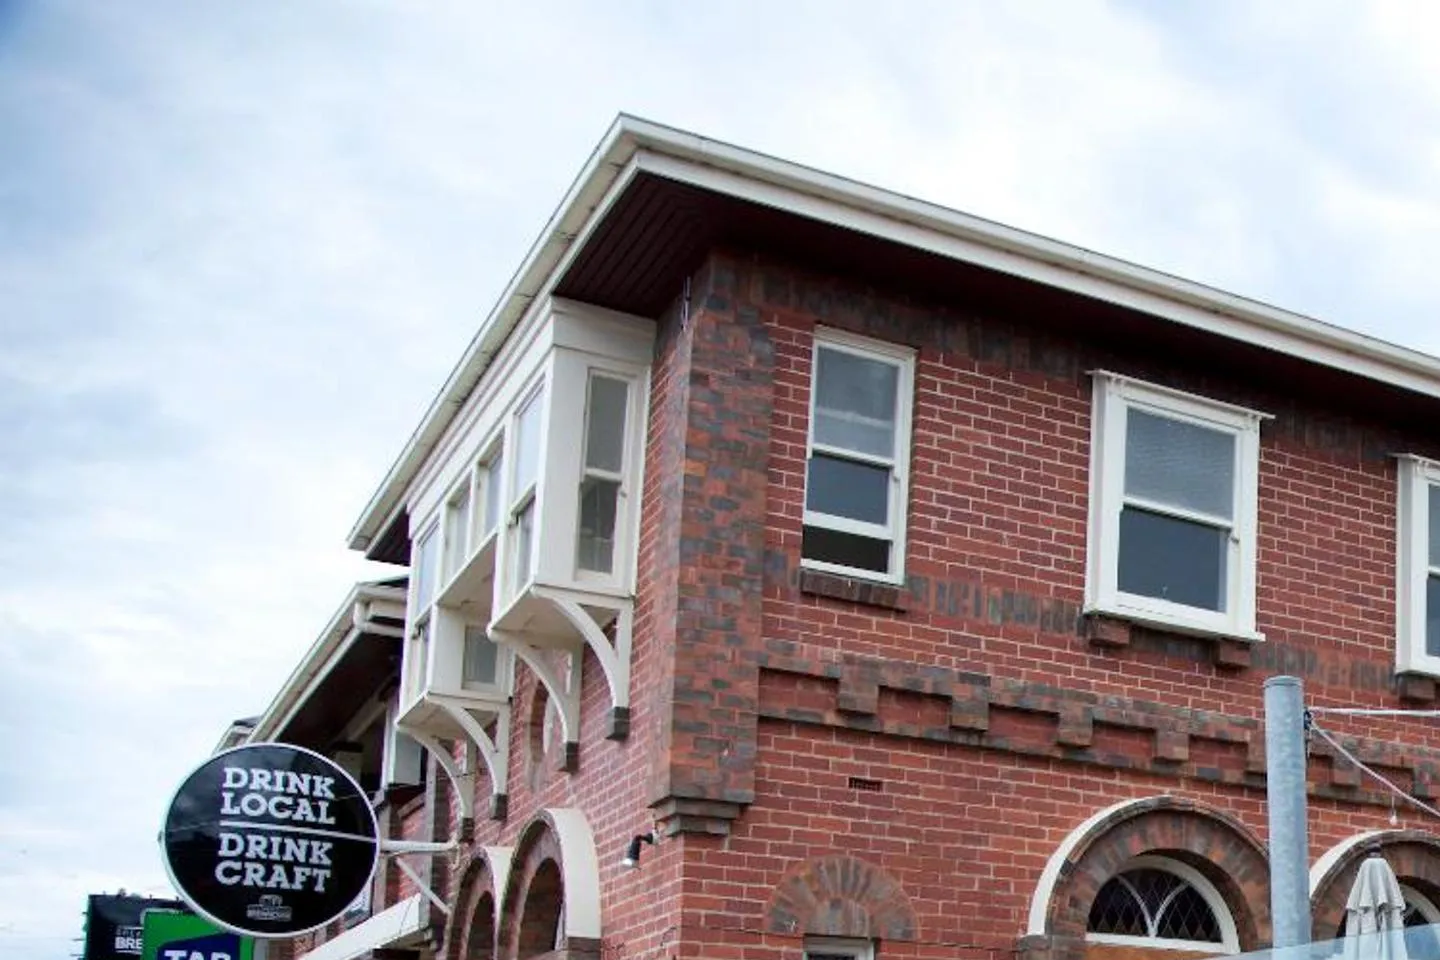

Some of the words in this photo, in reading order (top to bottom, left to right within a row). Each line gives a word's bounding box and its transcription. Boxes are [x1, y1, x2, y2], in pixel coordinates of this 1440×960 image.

[222, 766, 336, 799] DRINK
[220, 791, 336, 825] LOCAL
[217, 832, 333, 866] DRINK
[214, 860, 332, 892] CRAFT
